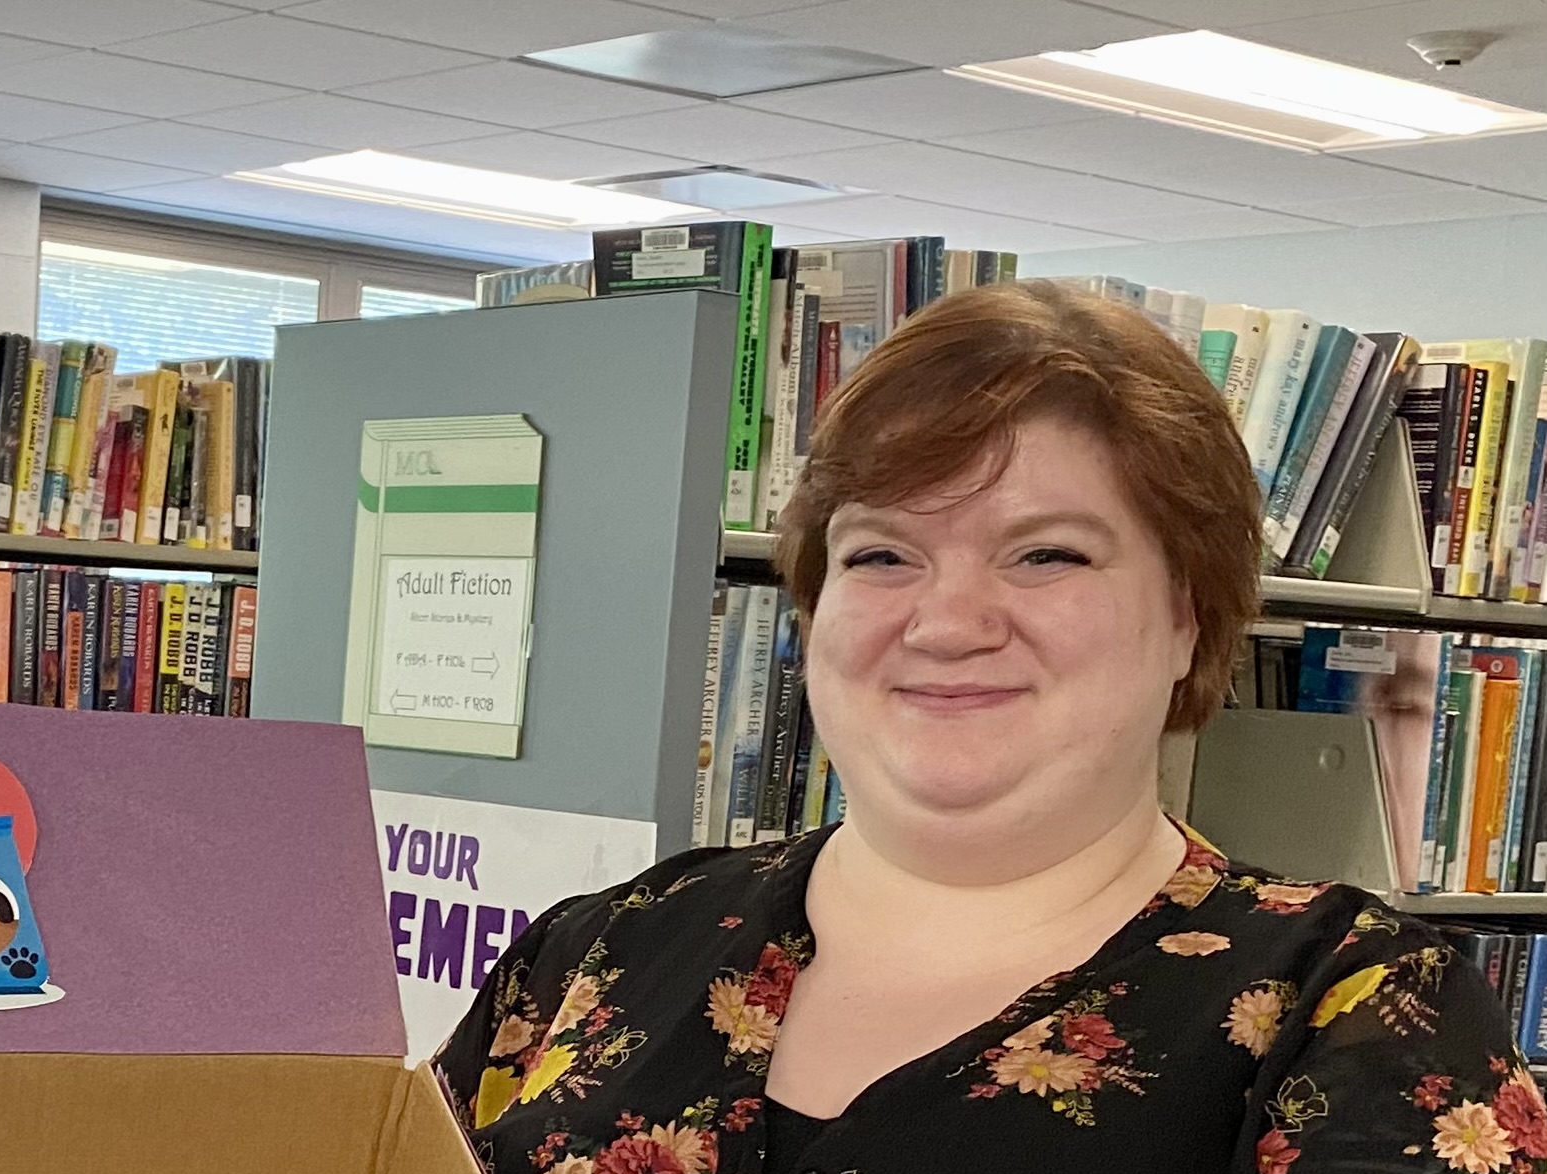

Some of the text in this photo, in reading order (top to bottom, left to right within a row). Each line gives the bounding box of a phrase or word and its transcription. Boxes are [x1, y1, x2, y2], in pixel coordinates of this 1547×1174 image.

[1471, 371, 1484, 408] PEARL
[33, 451, 42, 474] KATE
[189, 595, 203, 609] J.
[240, 600, 256, 614] J.
[396, 570, 513, 598] Adult Fiction
[22, 579, 34, 688] KAREN ROBARDS
[44, 583, 61, 652] KAREN ROBARDS
[83, 582, 97, 695] KAREN ROBARDS
[122, 584, 140, 658] KAREN ROBARDS
[166, 595, 184, 668] J. D. ROBB
[199, 597, 220, 683] J. D. ROBB
[238, 617, 254, 631] D.
[183, 631, 201, 677] ROBB
[234, 633, 253, 672] ROBB
[700, 616, 721, 737] JEFFREY ARCHER
[746, 618, 770, 736] JEFFREY ARCHER
[775, 666, 795, 718] Jeffrey
[772, 723, 788, 781] Archer
[385, 823, 480, 891] YOUR
[1515, 950, 1529, 988] TOM
